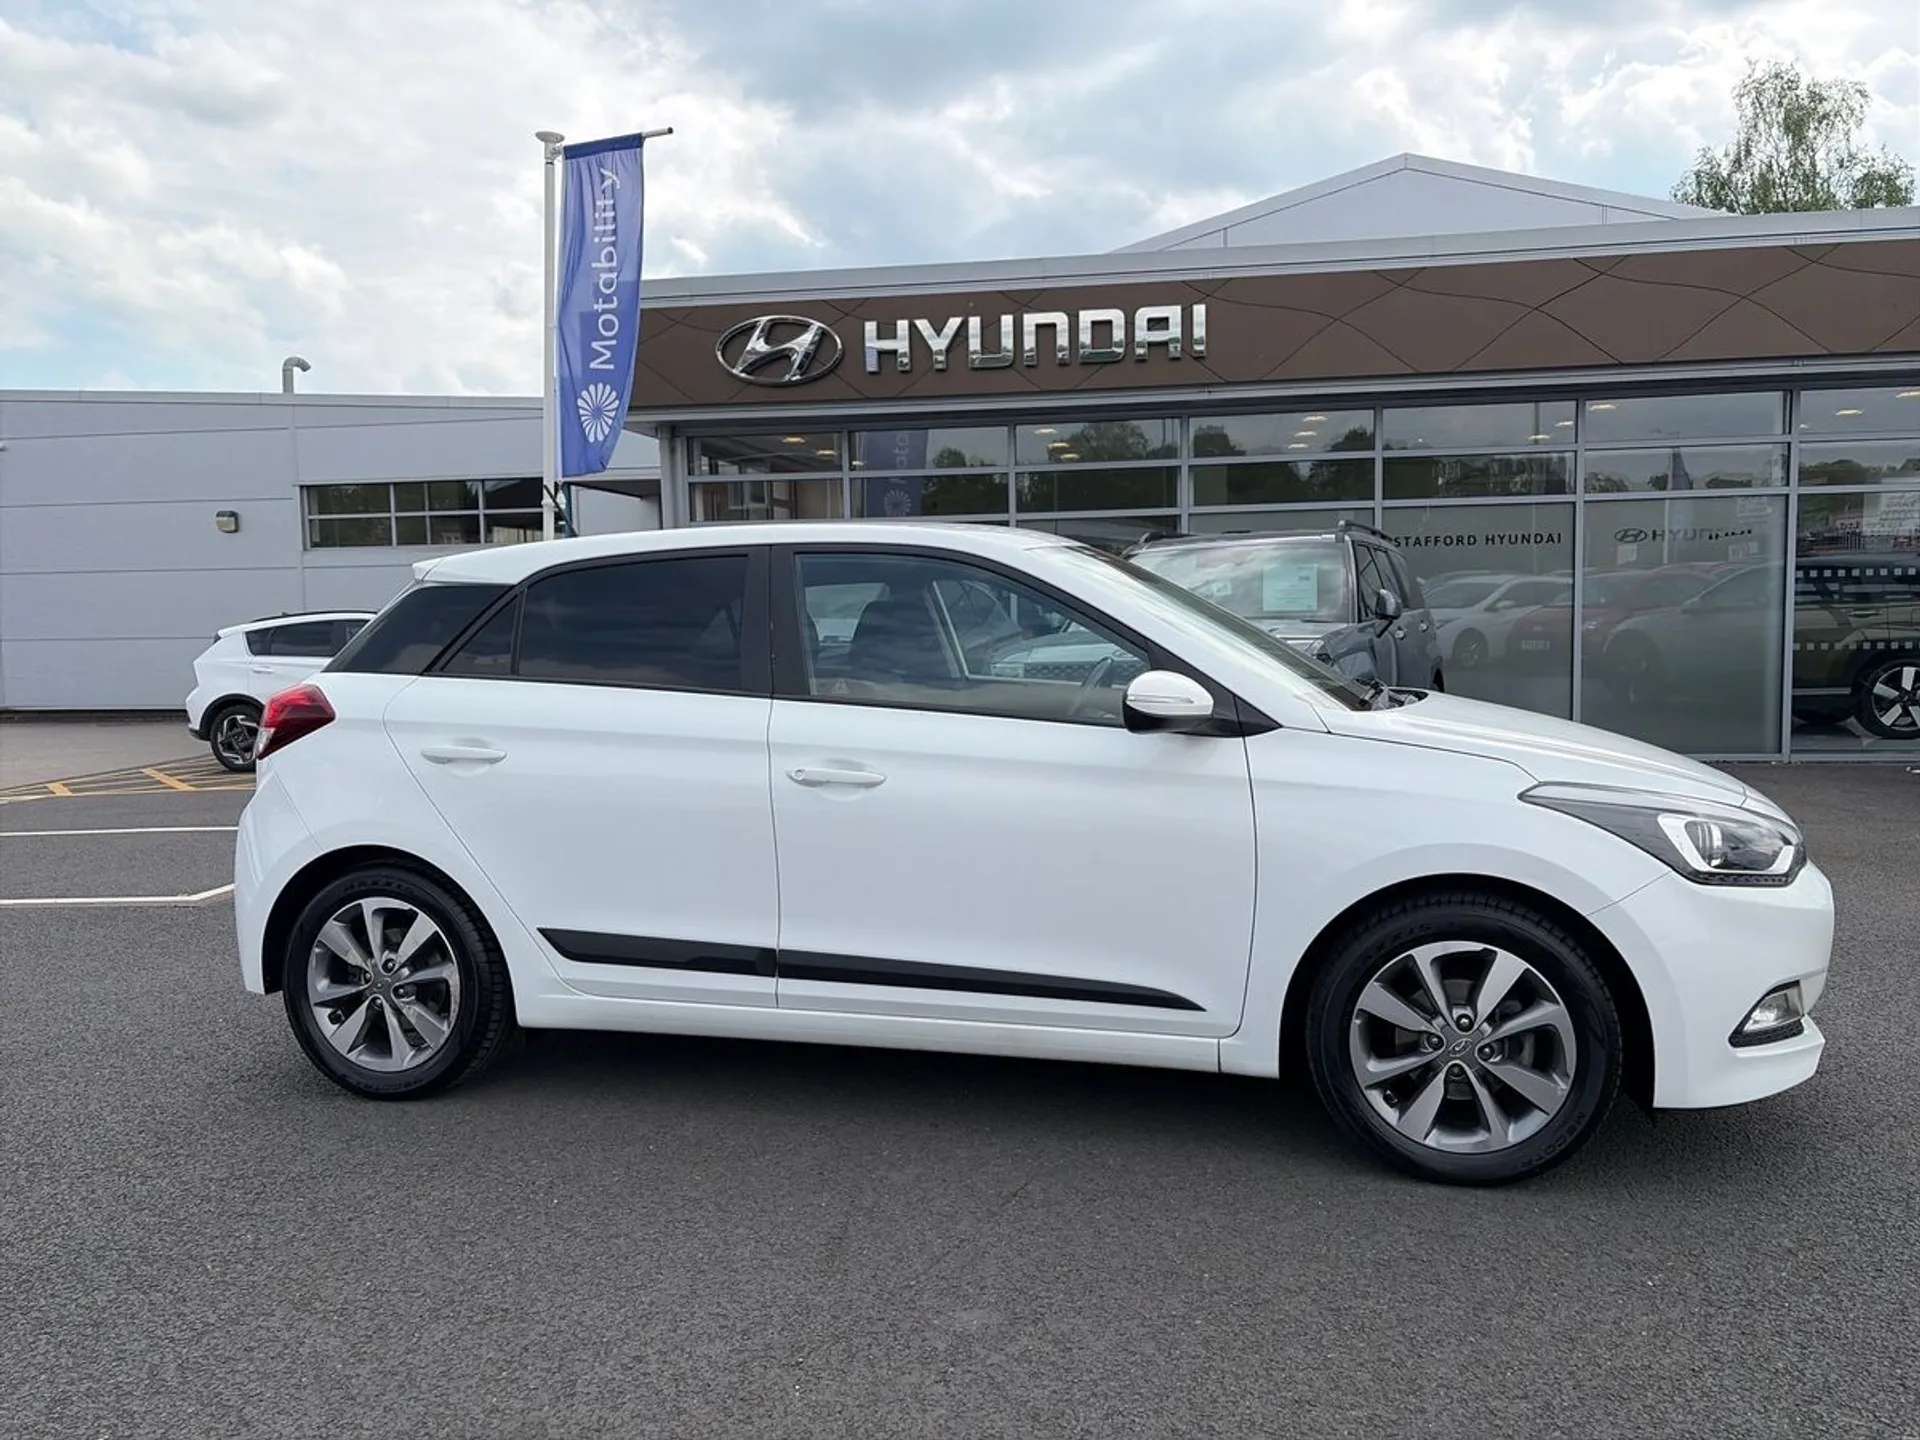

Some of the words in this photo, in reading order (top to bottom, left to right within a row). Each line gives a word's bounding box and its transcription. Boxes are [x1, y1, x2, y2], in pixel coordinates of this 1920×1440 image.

[589, 167, 621, 370] Motability
[863, 303, 1207, 374] HYUNDAI
[1394, 534, 1477, 548] STAFFORD
[1485, 532, 1562, 546] HYUNDAI
